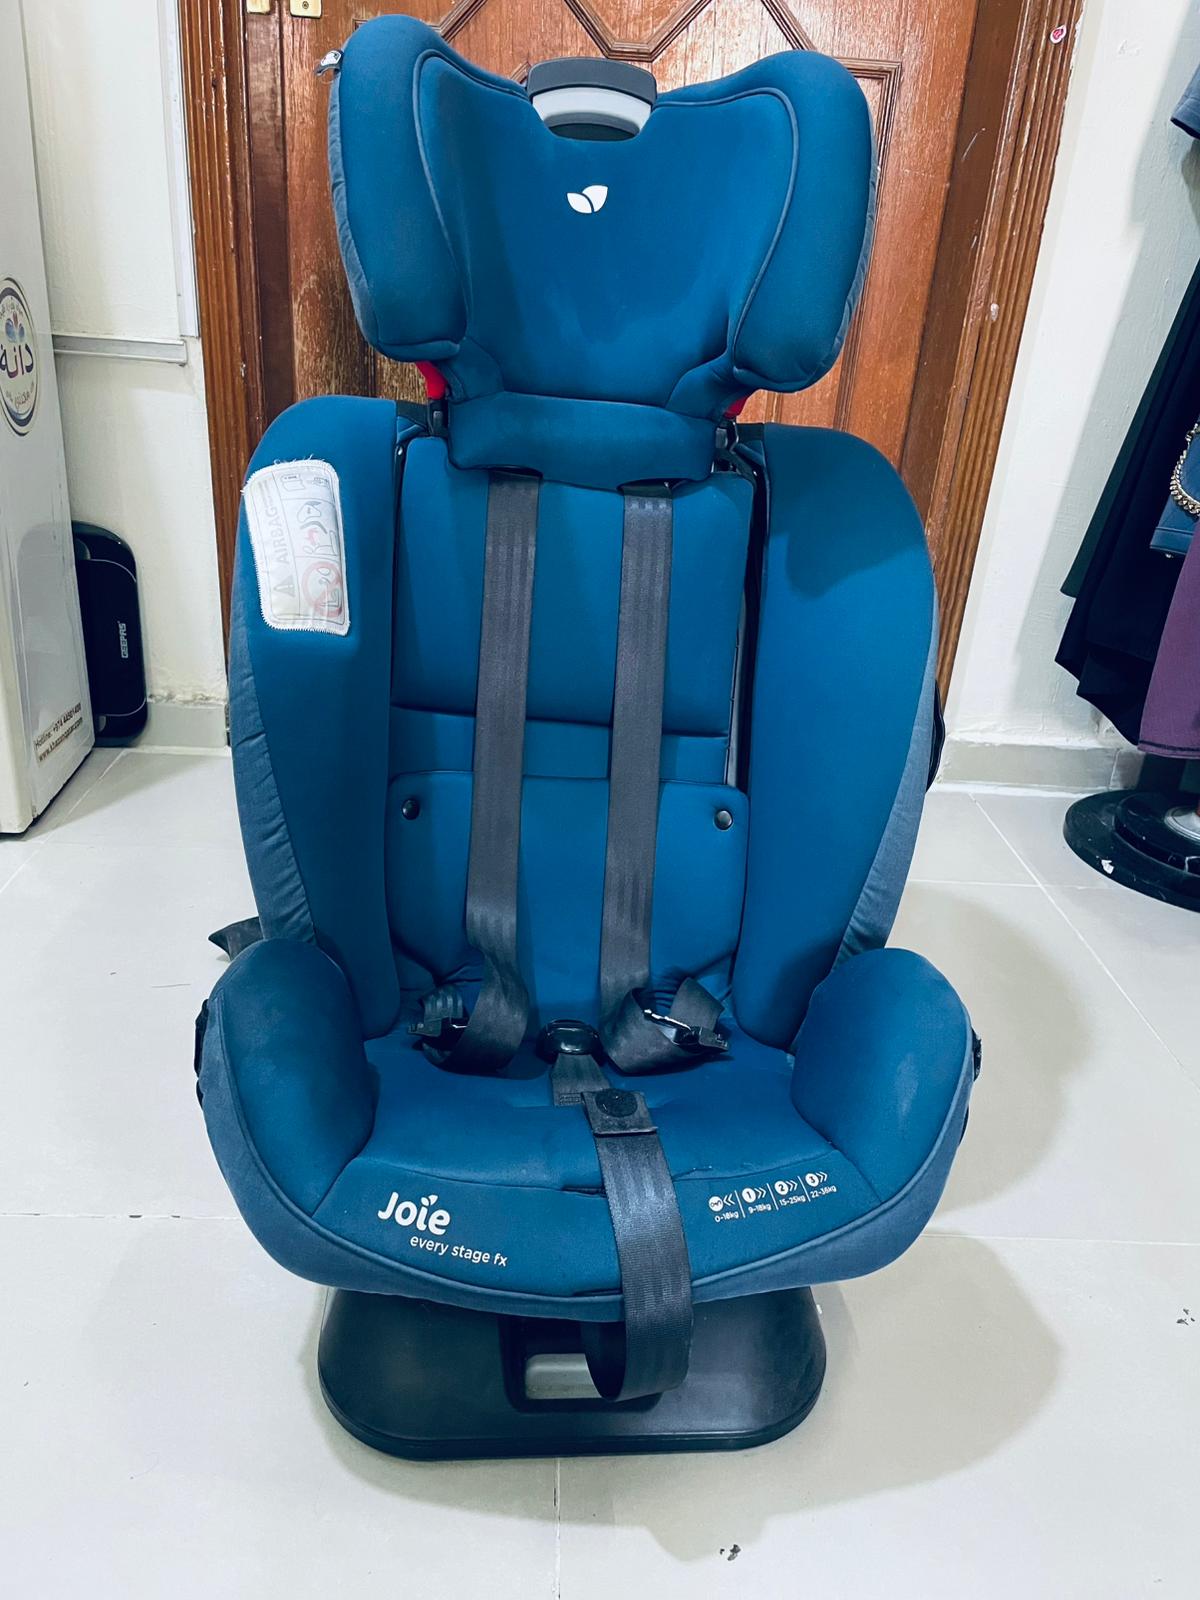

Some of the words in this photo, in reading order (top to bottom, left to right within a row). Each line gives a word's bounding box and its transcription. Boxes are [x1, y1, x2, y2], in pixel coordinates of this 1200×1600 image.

[265, 506, 290, 564] AIRBAG
[119, 622, 129, 659] GEEPAS
[377, 1191, 451, 1236] Joie
[714, 1210, 739, 1223] 0-18kg
[748, 1203, 772, 1214] 9-18kg
[779, 1194, 806, 1206] 15-25kg
[410, 1236, 449, 1256] every
[451, 1245, 491, 1264] stage
[493, 1252, 508, 1267] fx
